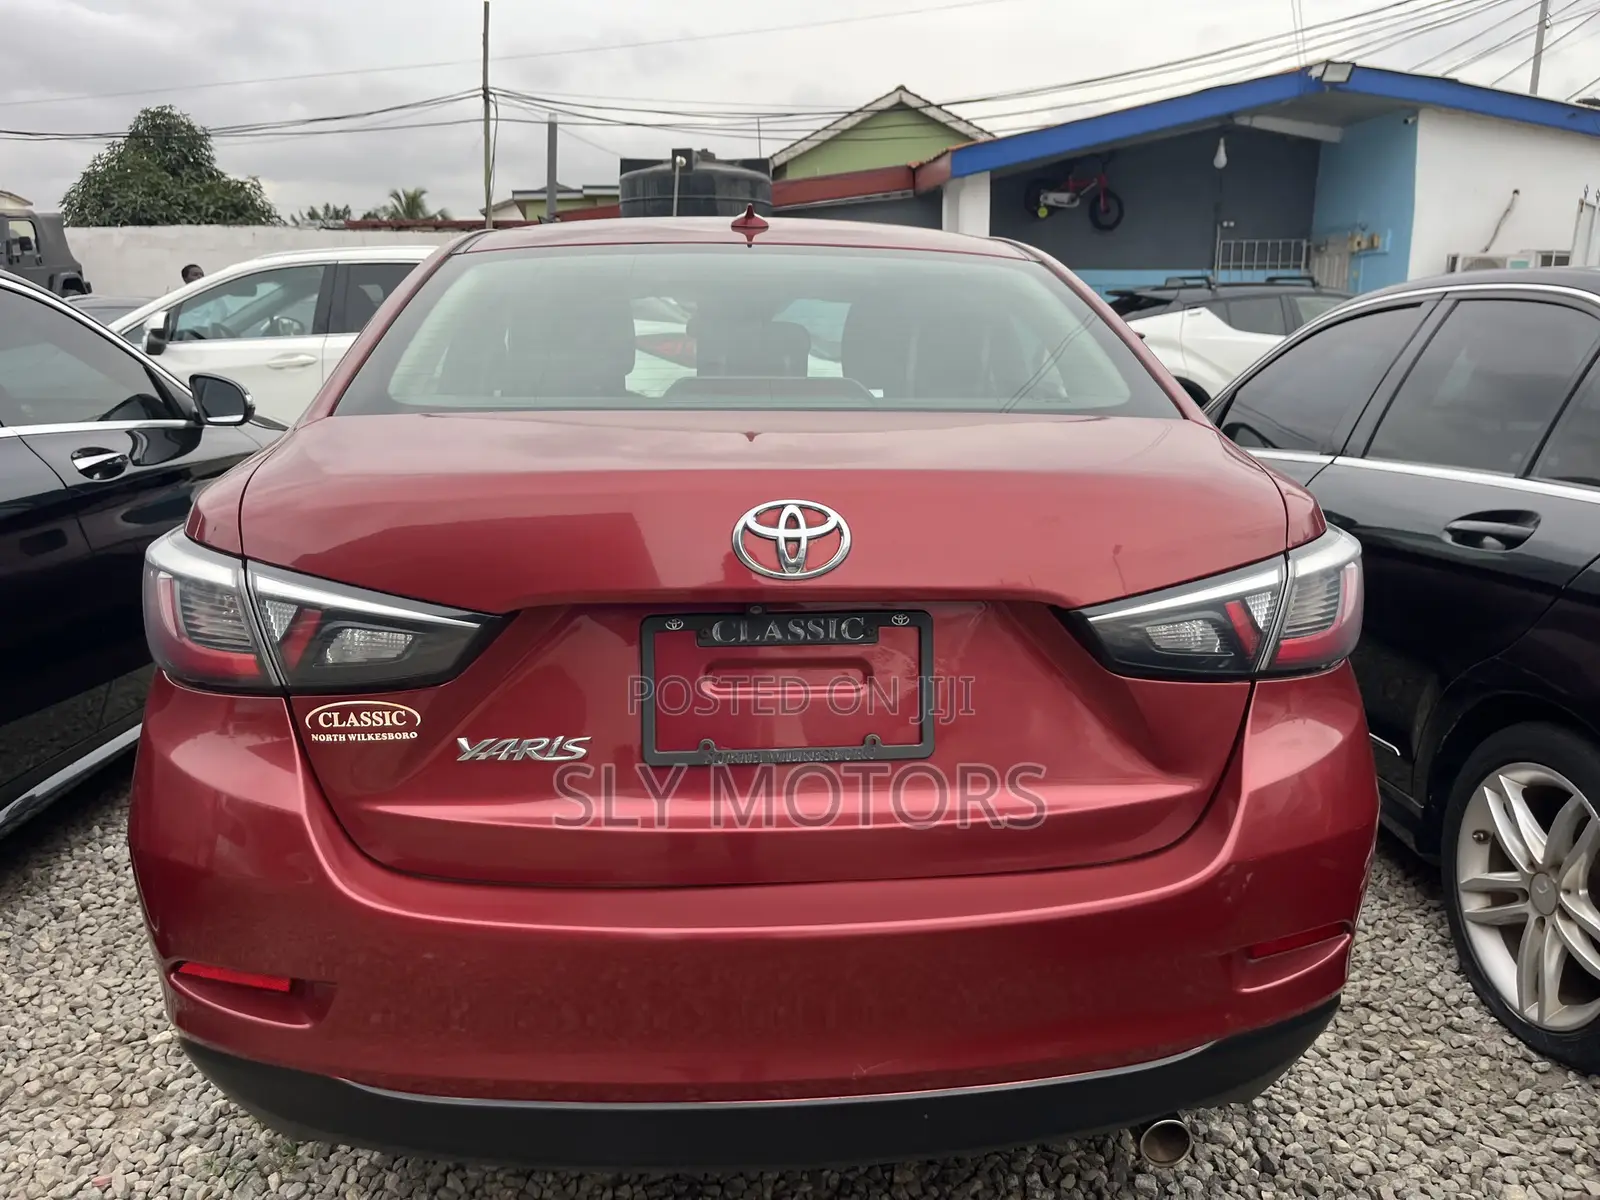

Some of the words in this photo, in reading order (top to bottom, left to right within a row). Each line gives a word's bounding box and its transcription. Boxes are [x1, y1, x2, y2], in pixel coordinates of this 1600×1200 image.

[711, 616, 865, 643] CLASSIC
[318, 710, 407, 728] CLASSIC
[311, 733, 346, 743] NORTH
[347, 731, 418, 742] WILKESBORO
[456, 735, 592, 762] YARIS
